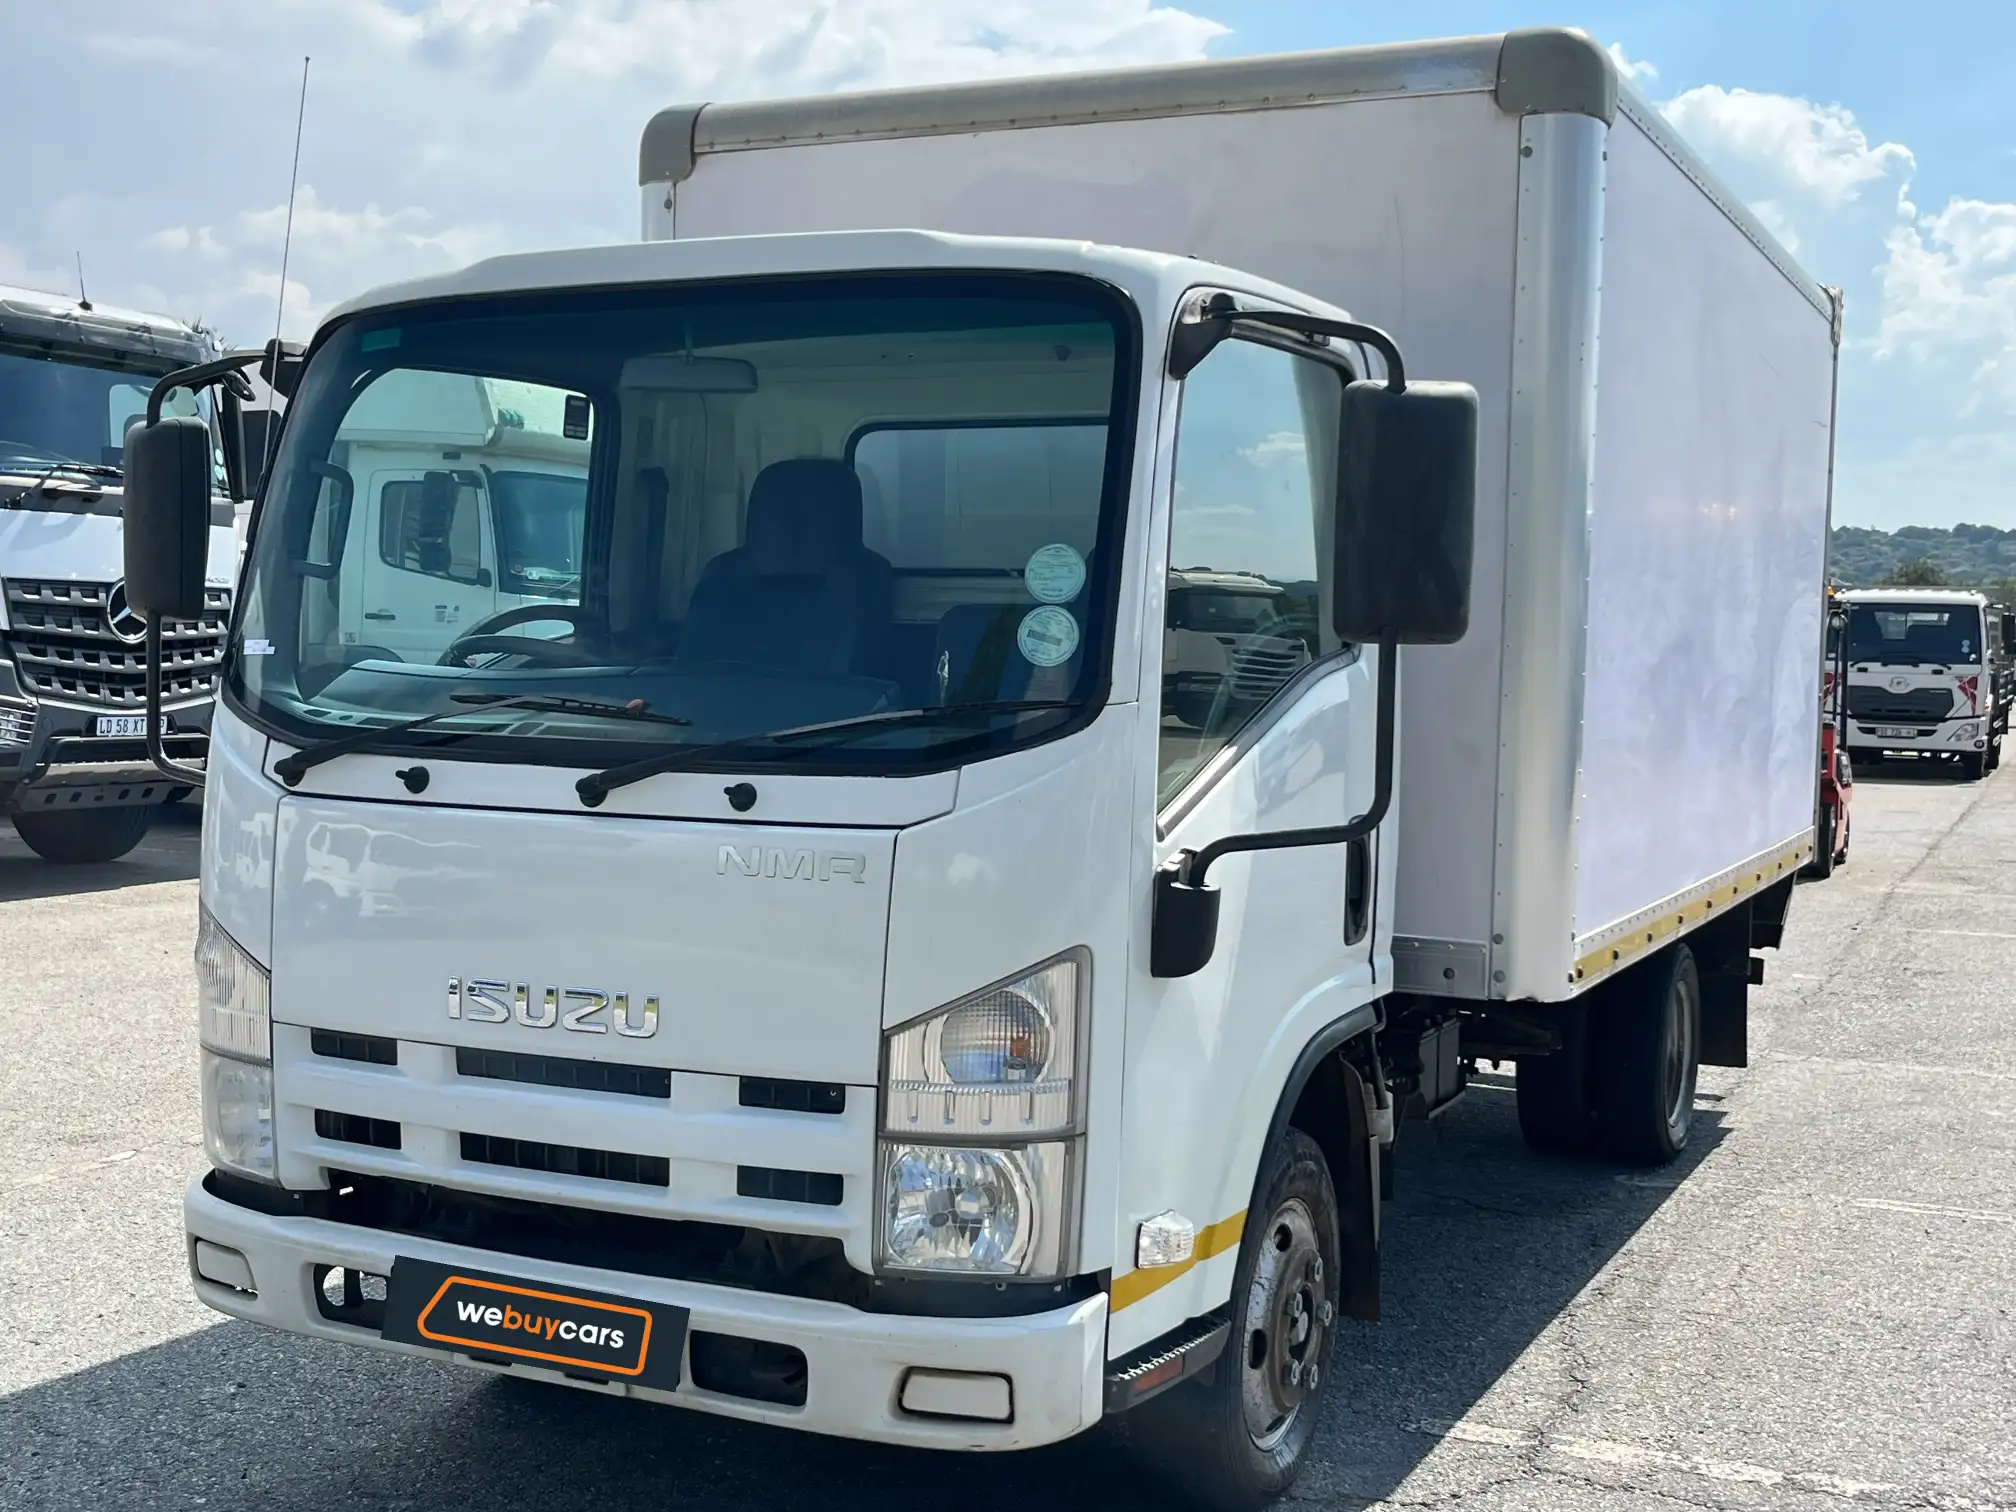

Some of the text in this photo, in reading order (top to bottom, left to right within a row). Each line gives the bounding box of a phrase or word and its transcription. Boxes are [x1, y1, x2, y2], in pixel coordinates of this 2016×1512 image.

[99, 719, 113, 734] LD
[116, 718, 129, 733] 58
[133, 718, 146, 733] XT
[716, 844, 866, 884] NMR
[448, 976, 660, 1039] ISUZU
